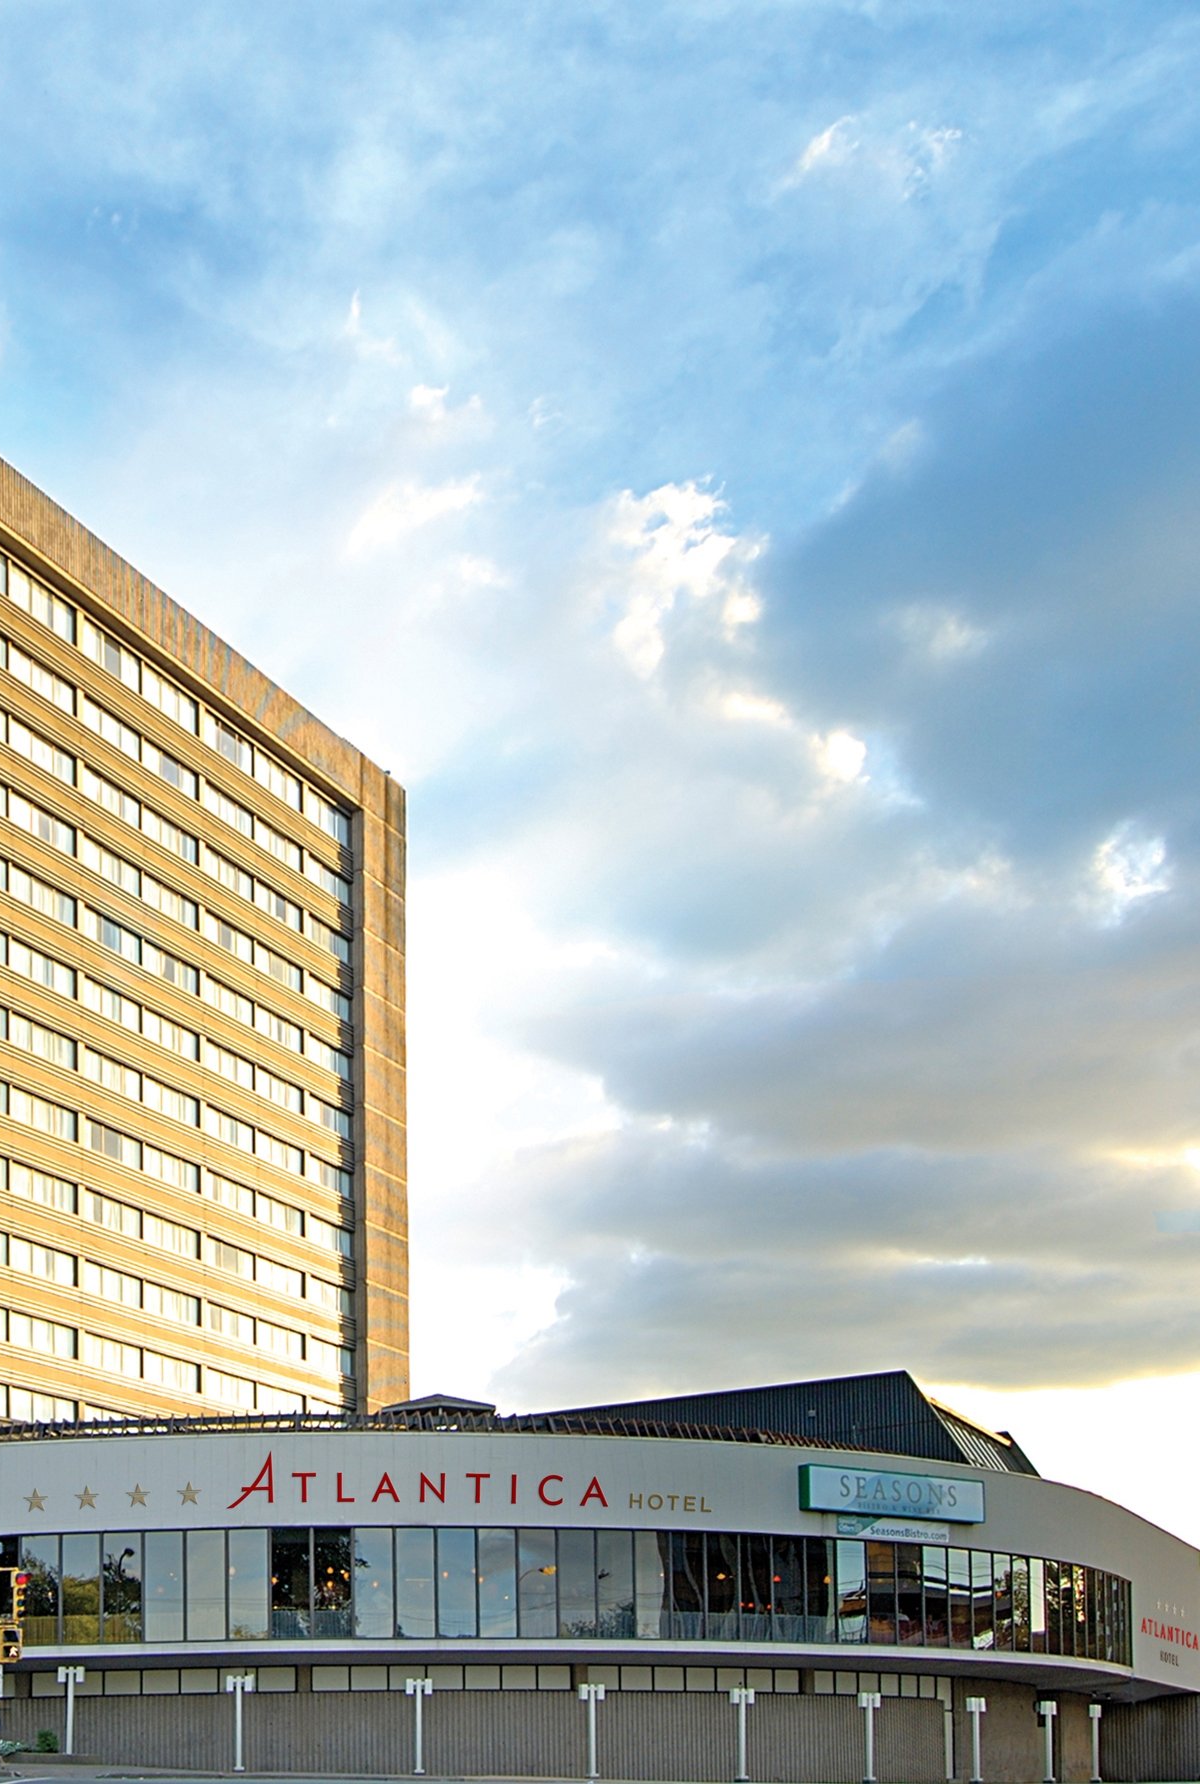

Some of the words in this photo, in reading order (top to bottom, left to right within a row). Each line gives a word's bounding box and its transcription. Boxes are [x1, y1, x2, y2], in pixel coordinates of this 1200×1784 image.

[227, 1451, 608, 1509] ATLANTICA
[629, 1493, 712, 1513] HOTEL
[840, 1474, 957, 1507] SEASONS
[870, 1526, 947, 1541] SeasonsBistro.com
[1141, 1617, 1199, 1650] ATLANTICA
[1160, 1650, 1180, 1667] HOTEL
